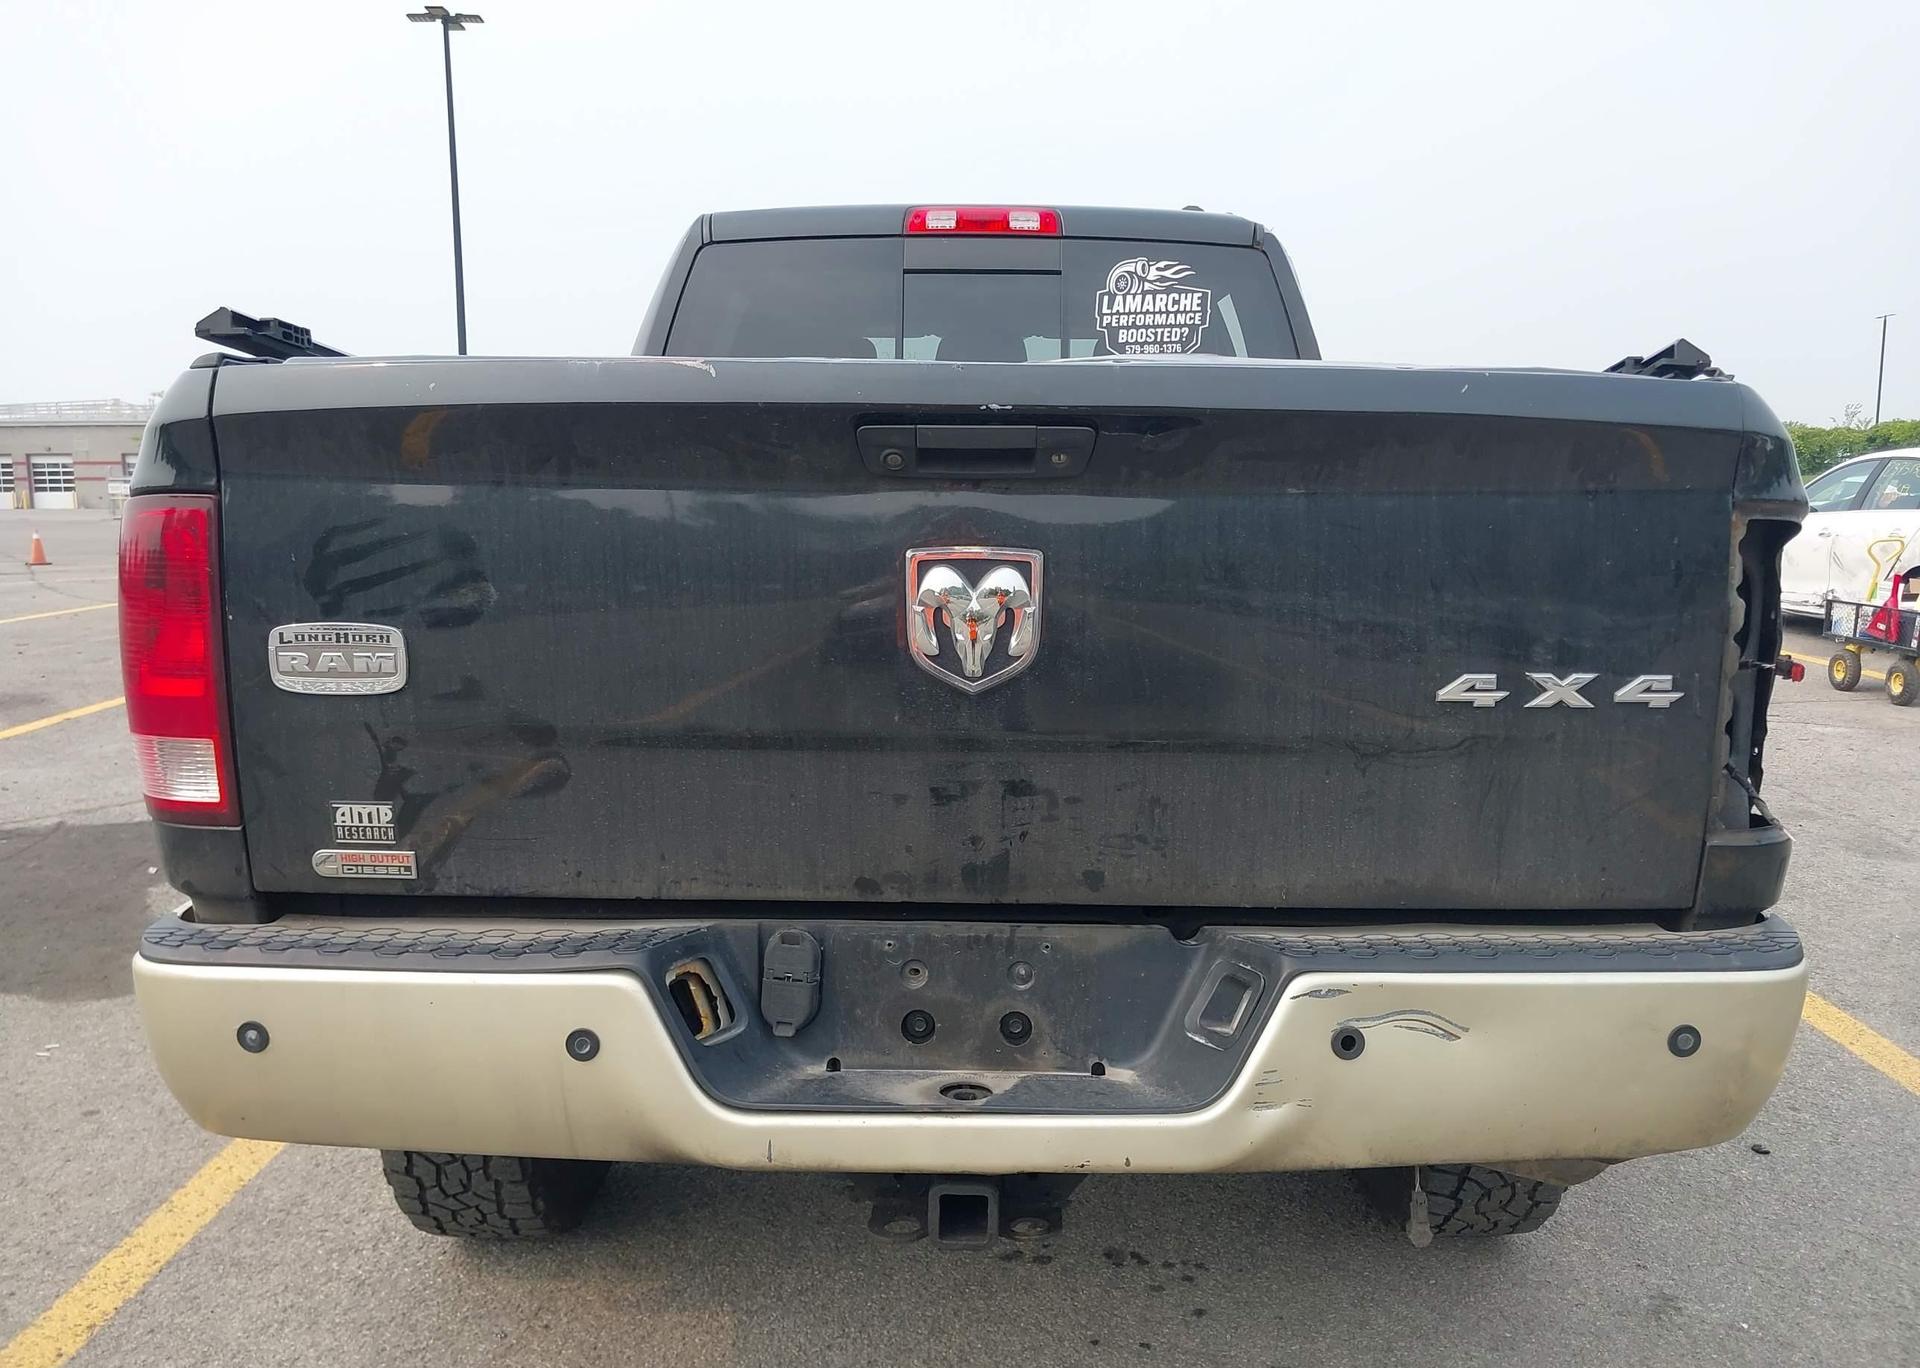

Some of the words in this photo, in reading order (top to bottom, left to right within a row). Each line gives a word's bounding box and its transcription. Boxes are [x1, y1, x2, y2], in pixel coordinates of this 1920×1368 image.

[1102, 293, 1202, 313] LAMARCHE
[1102, 313, 1202, 327] PERFORMANCE
[1118, 327, 1189, 343] BOOSTED?
[1125, 344, 1182, 354] 579-960-1376
[278, 652, 396, 673] RAM
[336, 826, 395, 840] RESEARCH
[340, 853, 366, 864] HIGH
[369, 853, 412, 865] OUTPUT
[343, 865, 411, 875] DIESEL
